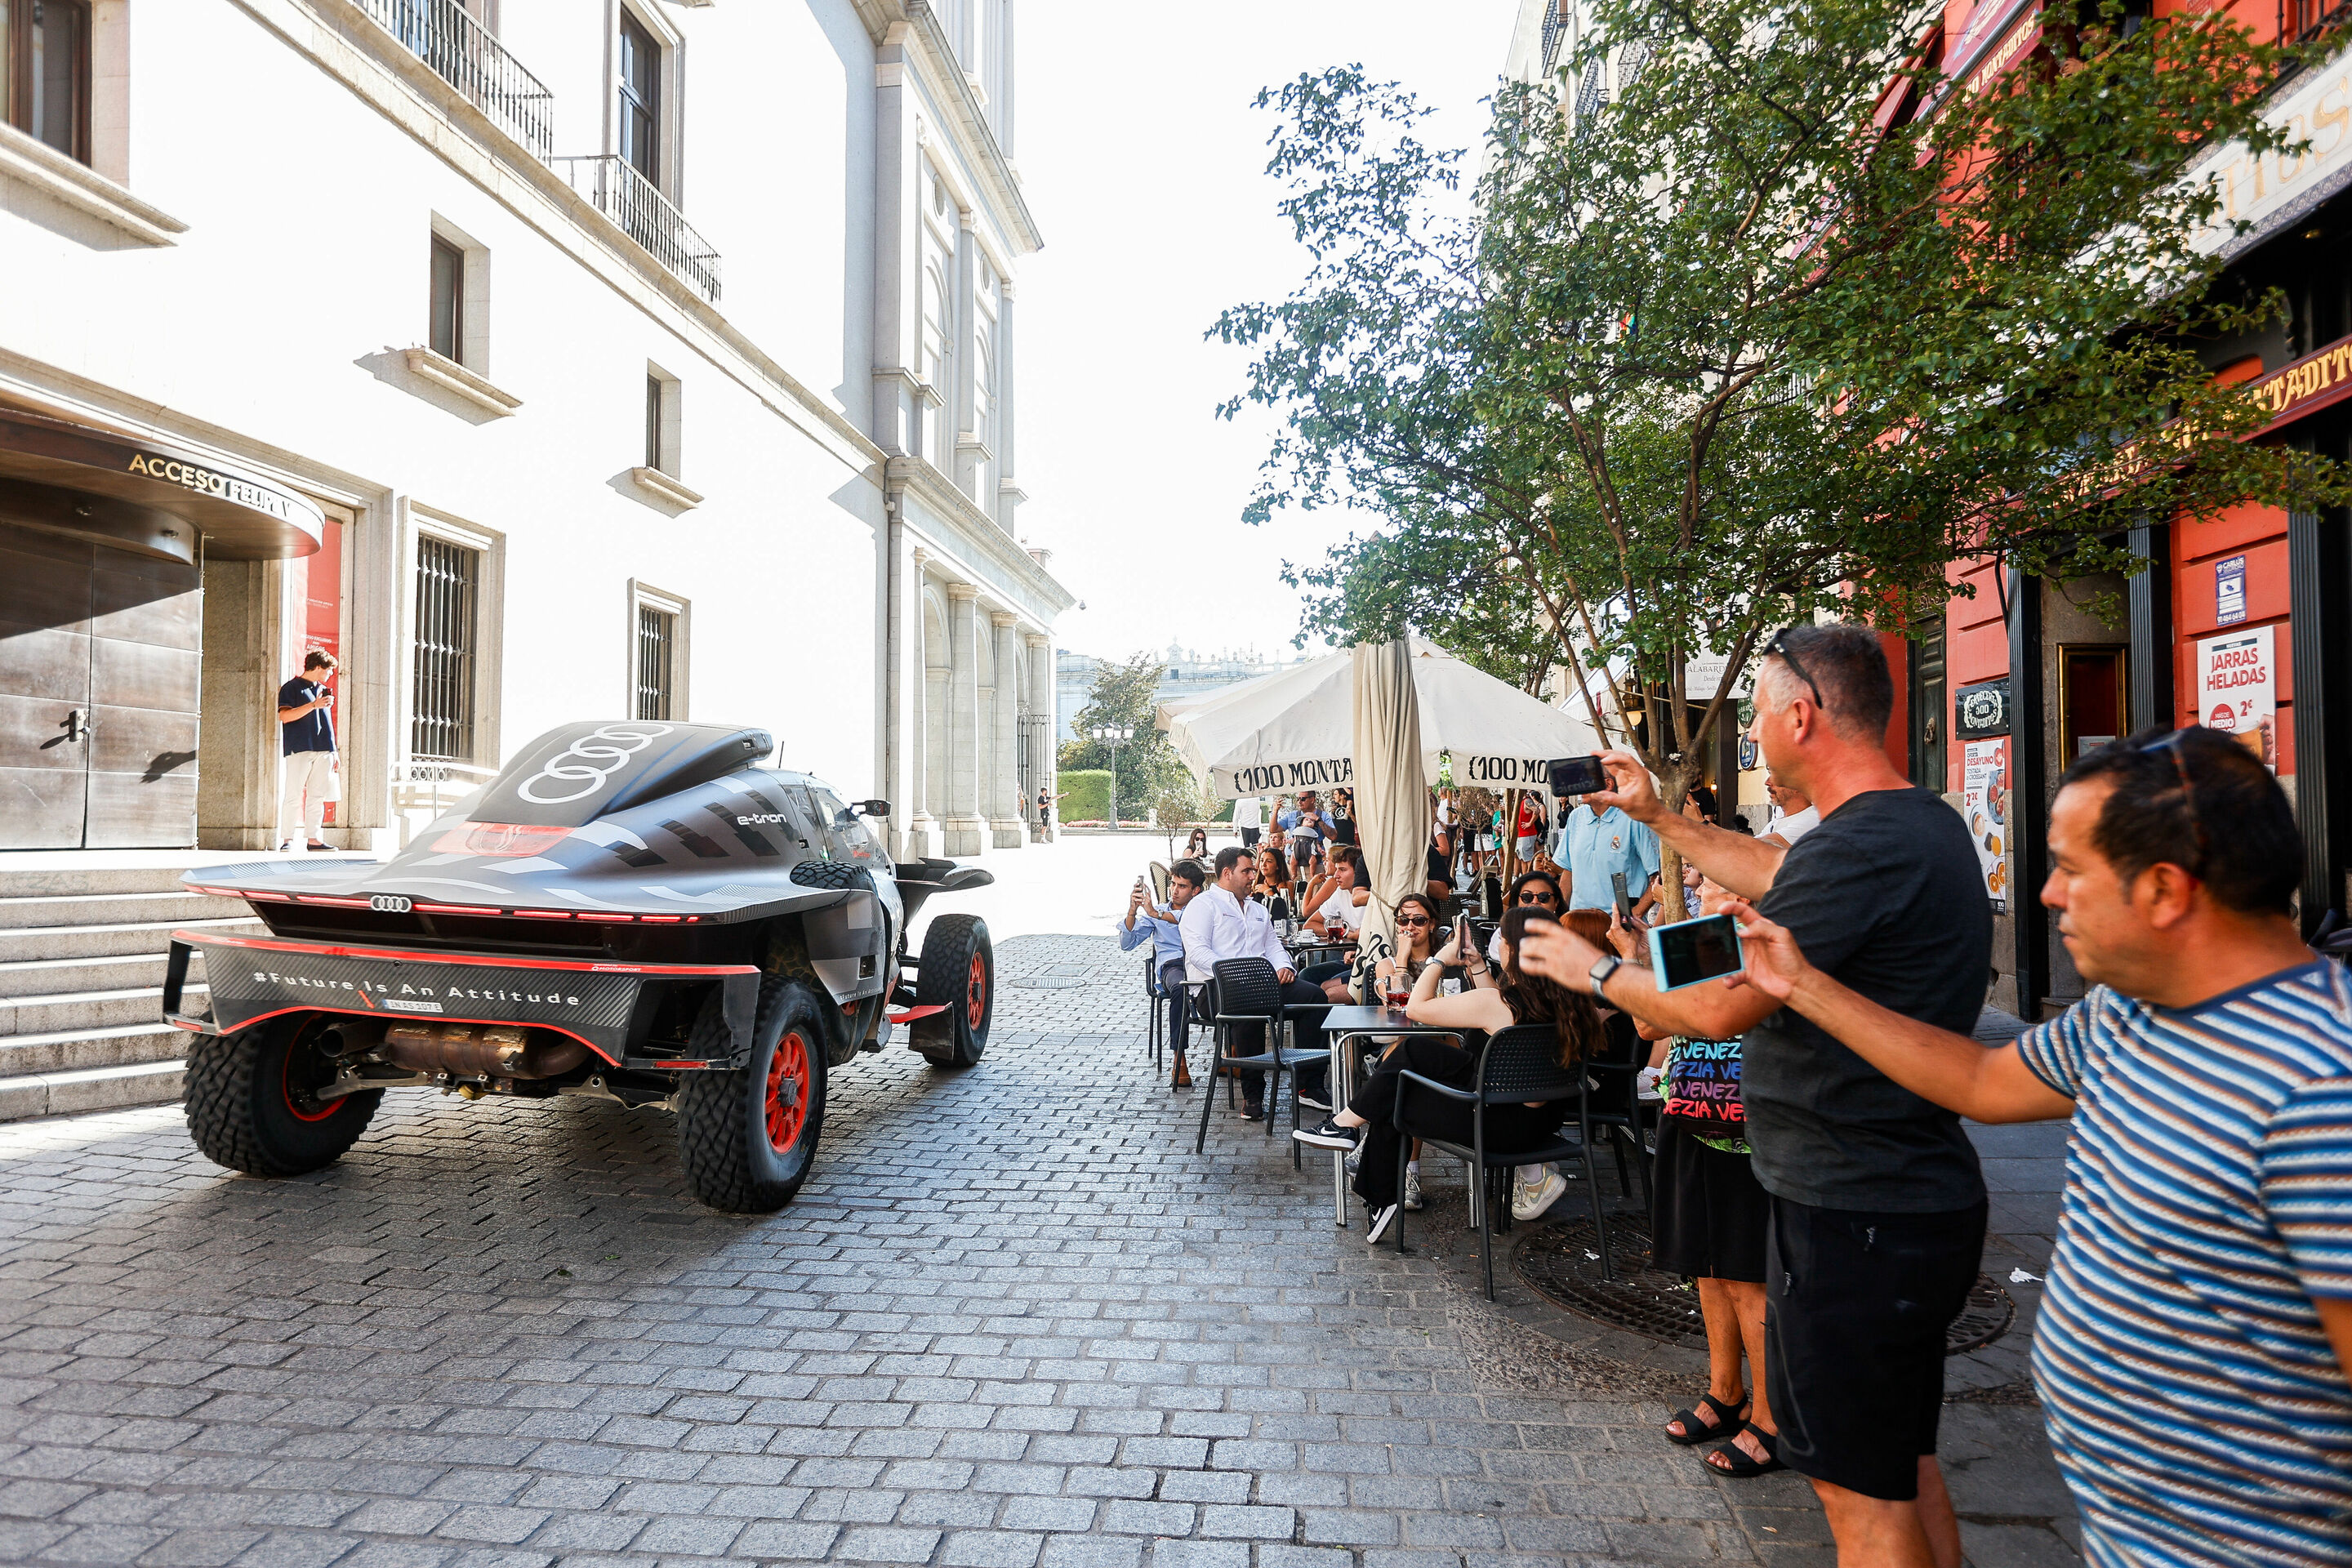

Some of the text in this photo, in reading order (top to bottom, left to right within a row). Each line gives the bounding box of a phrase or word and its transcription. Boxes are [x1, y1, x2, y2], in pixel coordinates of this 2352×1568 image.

[128, 454, 224, 493] ACCESO
[2211, 648, 2259, 673] JARRAS
[2206, 666, 2267, 691] HELADAS
[2240, 699, 2253, 716] 2€
[2210, 718, 2234, 728] MEDIO
[1289, 757, 1353, 787] MONTA
[1967, 755, 1994, 766] DESAYUNO
[737, 813, 787, 826] e-tron
[253, 972, 580, 1006] #Future Is An Attitude
